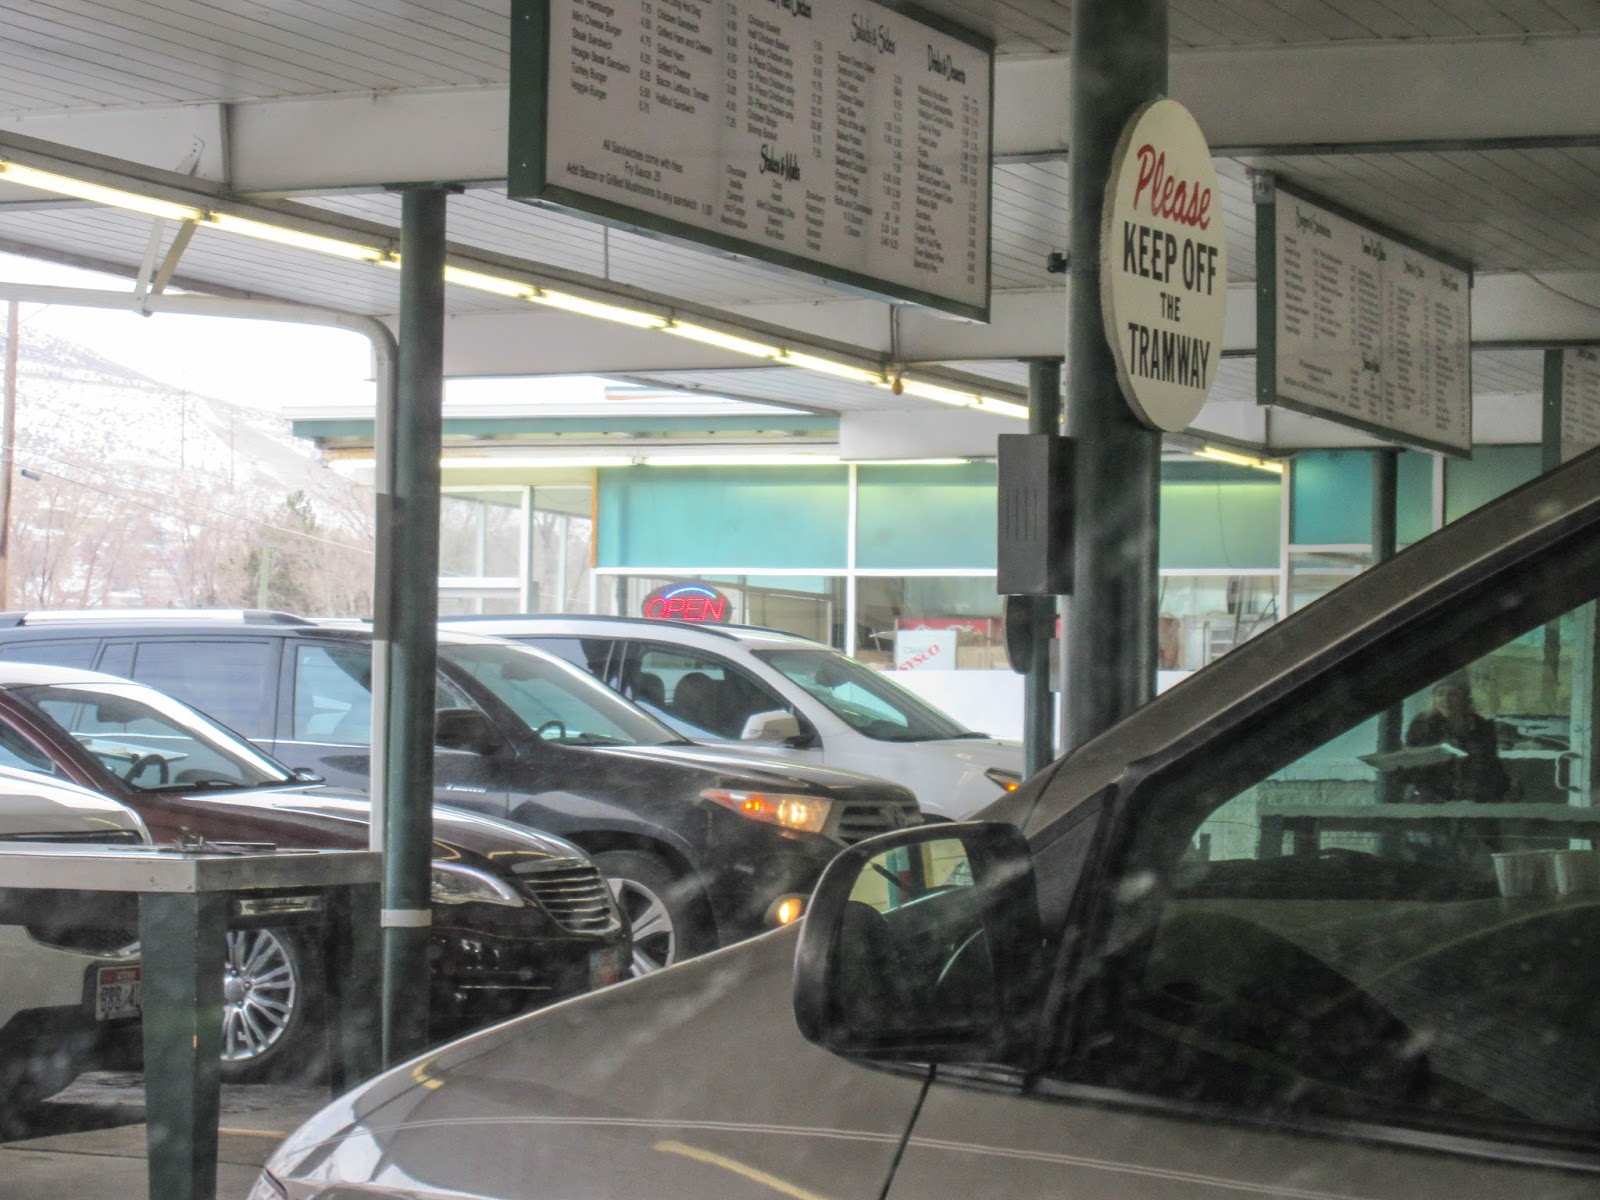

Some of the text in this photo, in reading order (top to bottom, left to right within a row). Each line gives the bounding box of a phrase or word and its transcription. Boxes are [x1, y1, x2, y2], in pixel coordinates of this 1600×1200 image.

[585, 14, 604, 30] Cheese
[605, 22, 622, 37] Burger
[677, 16, 698, 32] Sandwich
[852, 13, 871, 44] Salads
[878, 25, 895, 54] Sides
[572, 28, 586, 41] Steak
[588, 33, 612, 50] Sandwich
[696, 40, 712, 54] Cheese
[572, 62, 588, 78] Turkey
[590, 68, 607, 84] Burger
[592, 51, 605, 64] Steak
[606, 56, 630, 73] Sandwich
[590, 85, 606, 100] Burger
[673, 98, 695, 114] Sandwich
[612, 141, 643, 161] Sandwiches
[644, 154, 658, 166] come
[660, 159, 670, 169] with
[625, 161, 633, 176] Fry
[634, 164, 651, 180] Sauce
[567, 163, 578, 175] Add
[579, 165, 598, 180] Bacon
[606, 173, 623, 188] Grilled
[673, 196, 697, 210] sandwich
[1134, 144, 1211, 231] Please
[1123, 221, 1177, 284] KEEP
[1182, 238, 1218, 296] OFF
[1160, 292, 1181, 322] THE
[1128, 322, 1210, 390] TRAMWAY
[644, 597, 726, 622] OPEN
